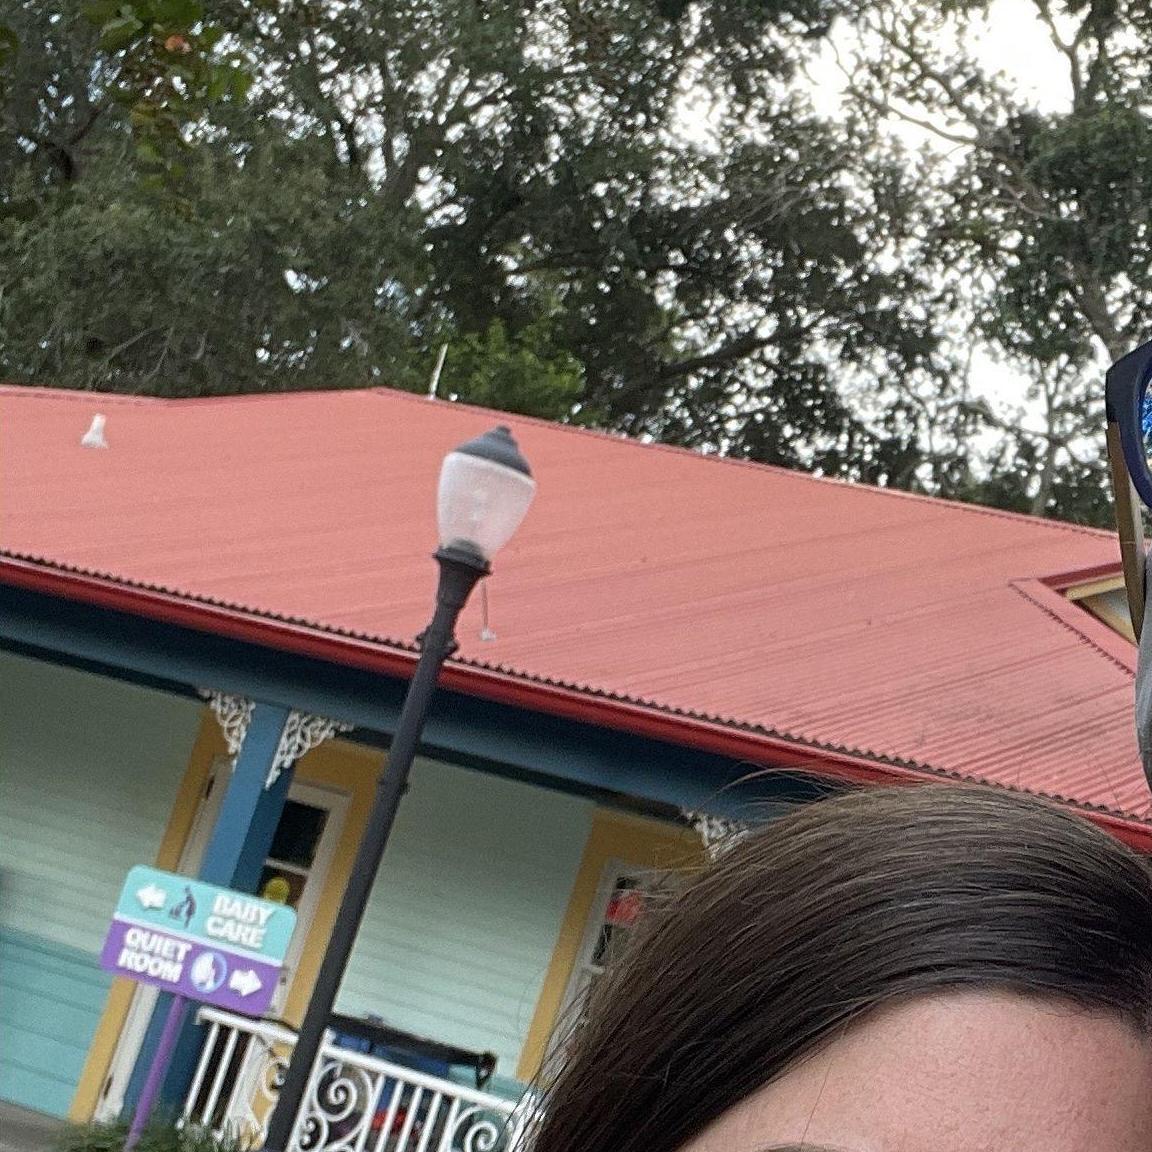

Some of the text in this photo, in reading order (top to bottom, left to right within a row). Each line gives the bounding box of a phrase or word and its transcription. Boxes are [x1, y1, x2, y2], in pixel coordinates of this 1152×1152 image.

[213, 893, 272, 925] BABY
[125, 928, 192, 962] QUIET
[207, 915, 267, 948] CARE
[117, 949, 183, 983] ROOM
